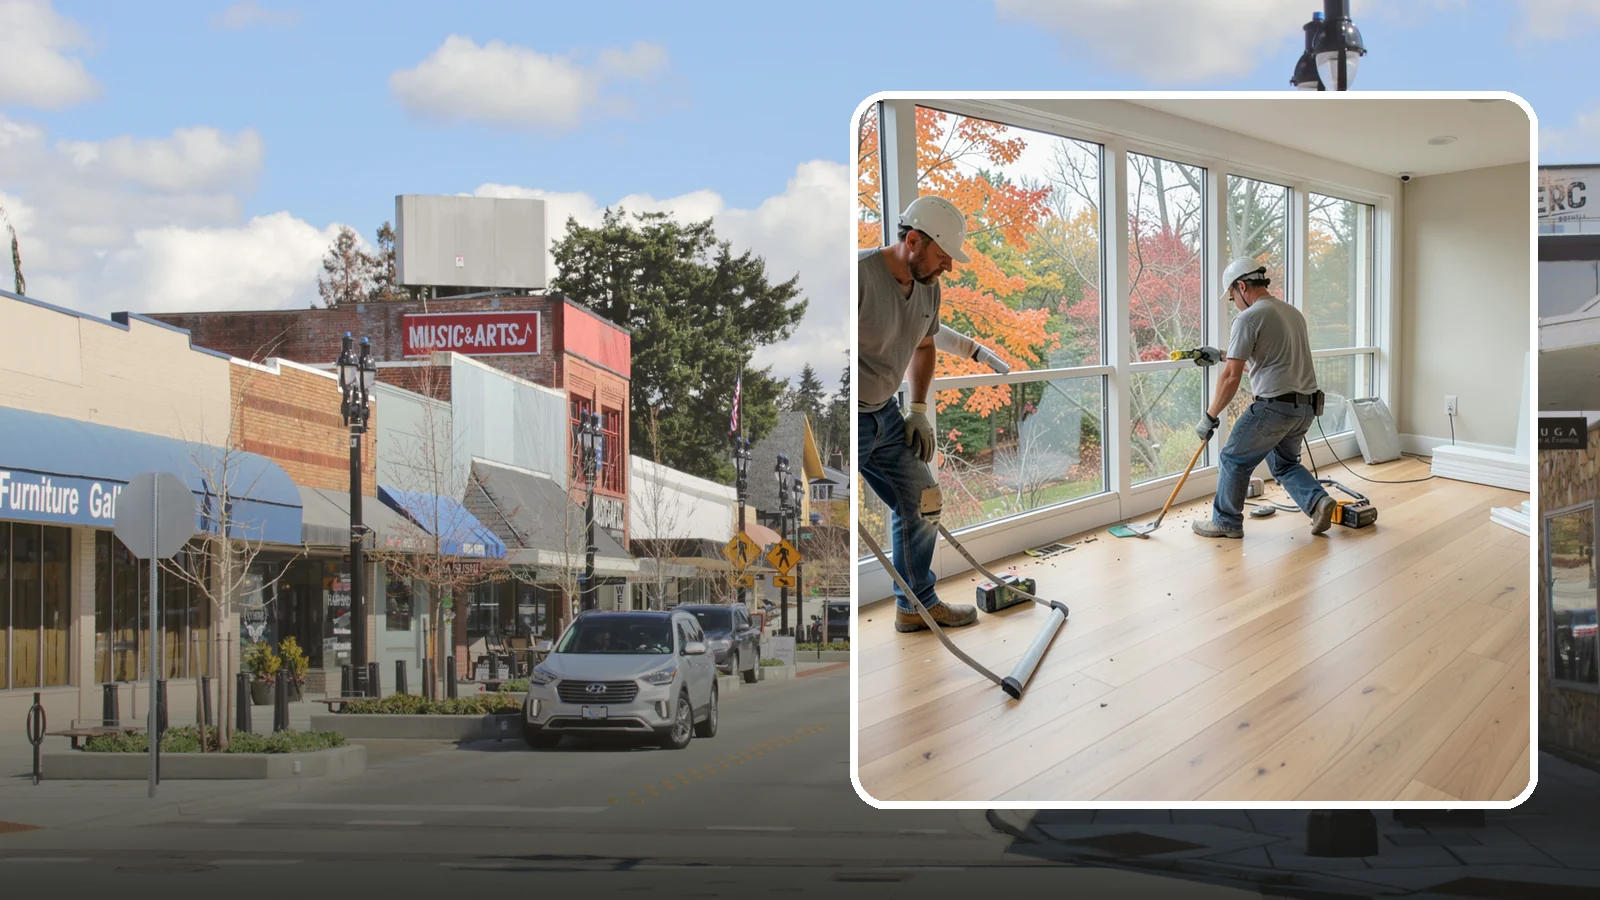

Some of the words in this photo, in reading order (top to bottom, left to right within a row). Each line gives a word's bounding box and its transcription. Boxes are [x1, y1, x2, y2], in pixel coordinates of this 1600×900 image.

[1540, 427, 1578, 436] UGA
[0, 471, 79, 515] Furniture
[454, 562, 480, 574] SUSHI
